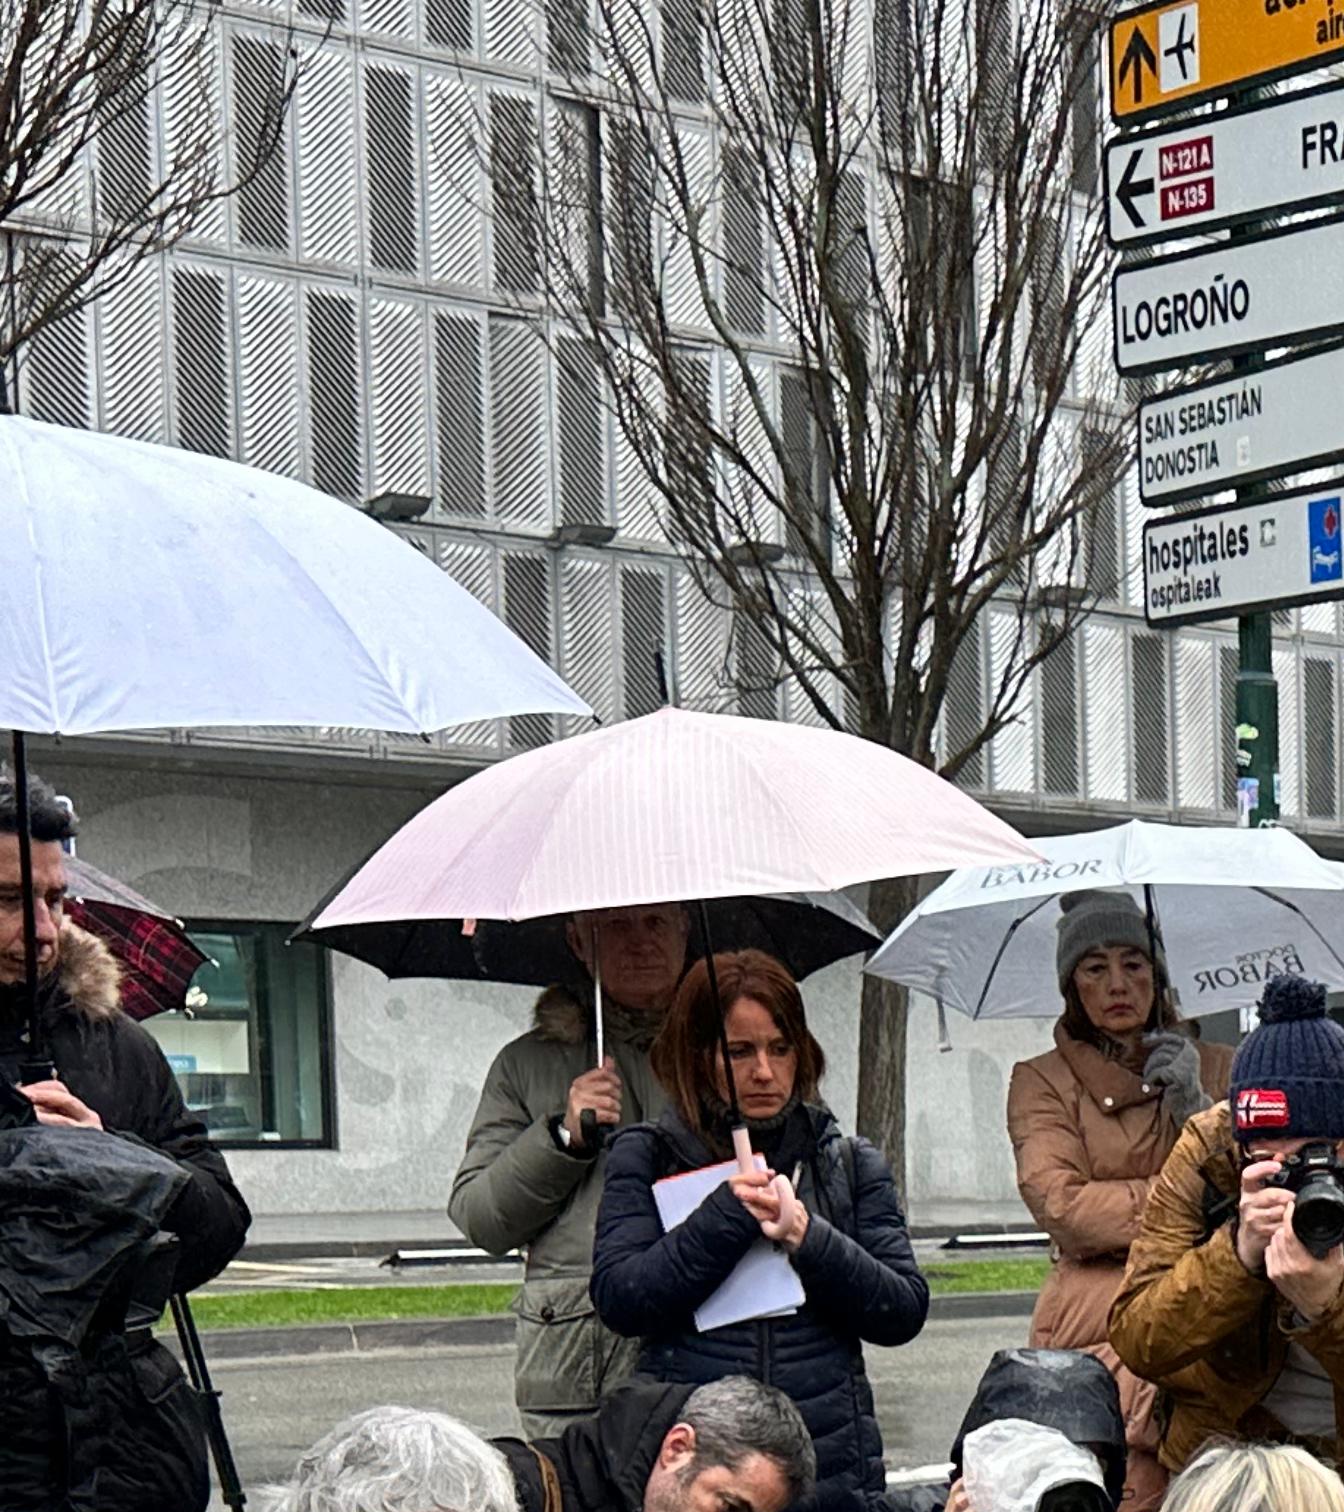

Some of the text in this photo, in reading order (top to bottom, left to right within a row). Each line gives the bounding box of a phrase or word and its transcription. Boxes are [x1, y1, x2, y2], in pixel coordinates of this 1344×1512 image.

[1168, 184, 1208, 213] N-135
[1122, 273, 1249, 344] LOGROÑO
[1145, 380, 1262, 444] SAN SEBASTIÁN
[1145, 439, 1219, 484] DONOSTIA
[1148, 521, 1249, 576] hospitales
[1151, 570, 1221, 613] ospitaleak
[980, 859, 1102, 888] BABOR
